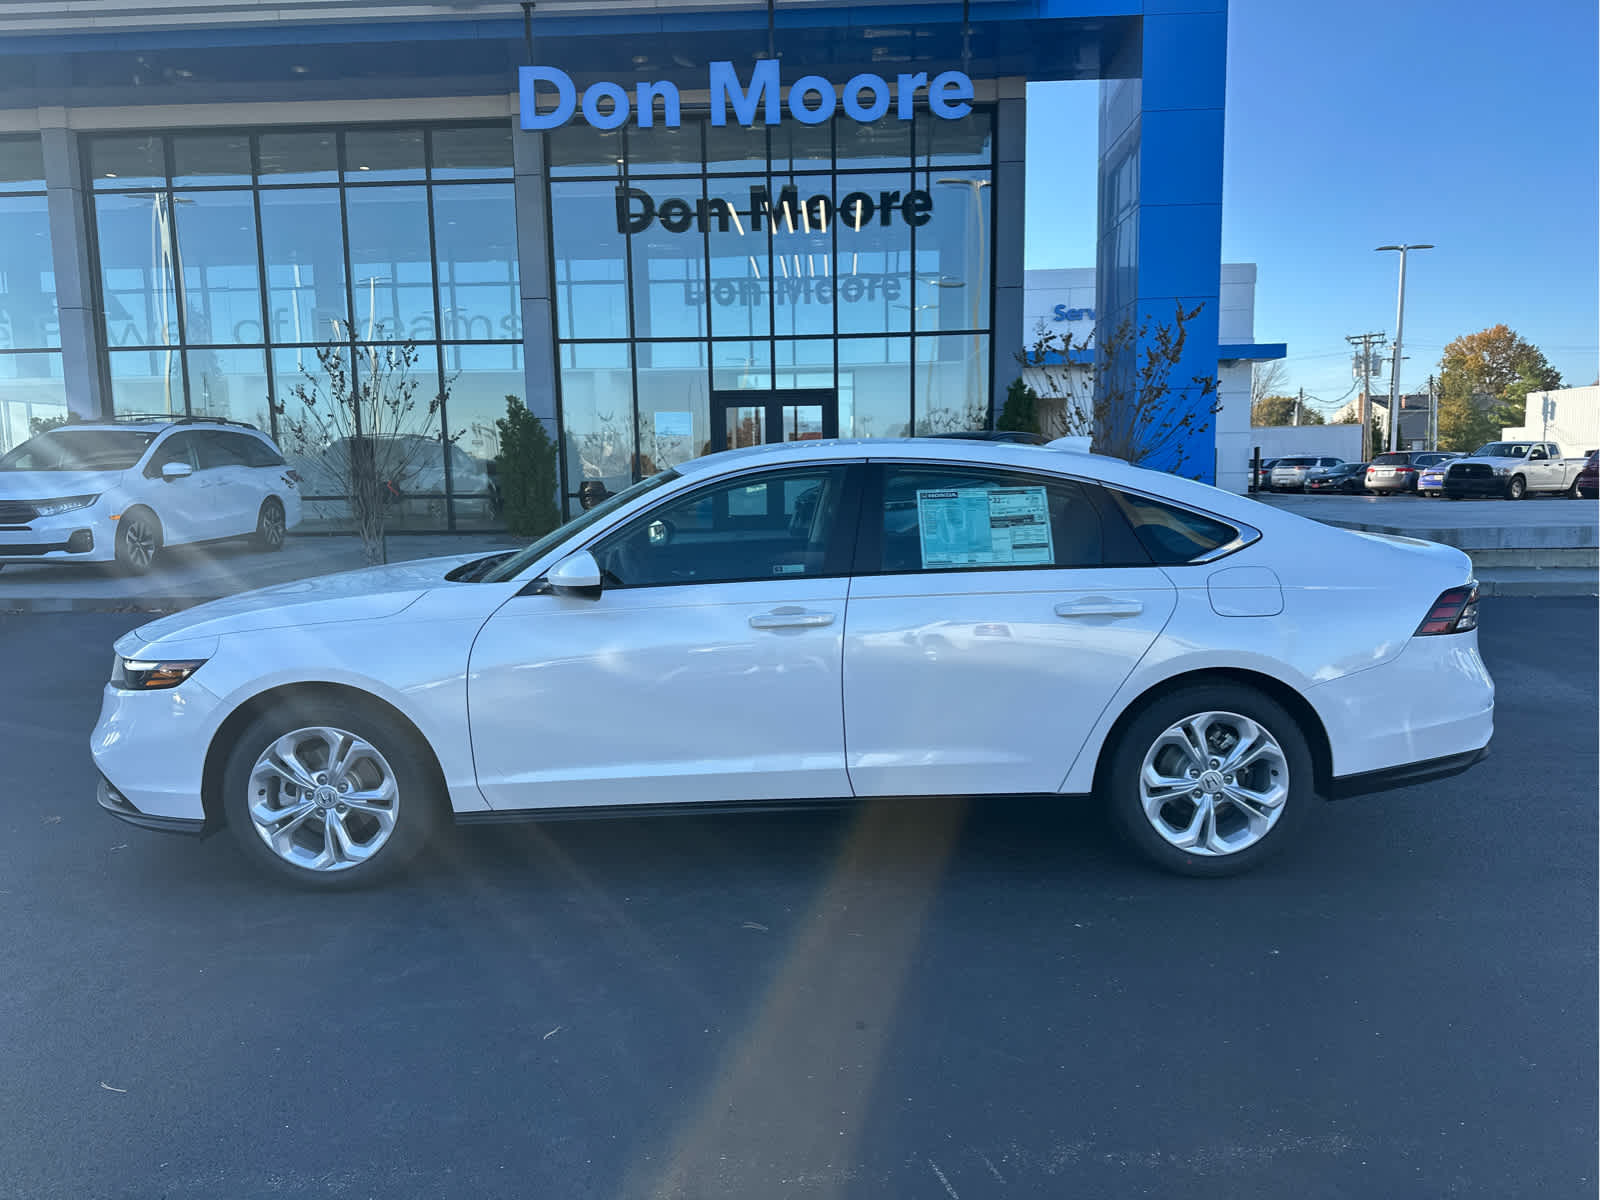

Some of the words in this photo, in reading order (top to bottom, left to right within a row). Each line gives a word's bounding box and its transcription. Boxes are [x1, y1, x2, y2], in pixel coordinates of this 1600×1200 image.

[518, 65, 680, 131] Don
[709, 58, 975, 127] Moore
[615, 185, 730, 234] Don
[750, 184, 933, 232] Moore
